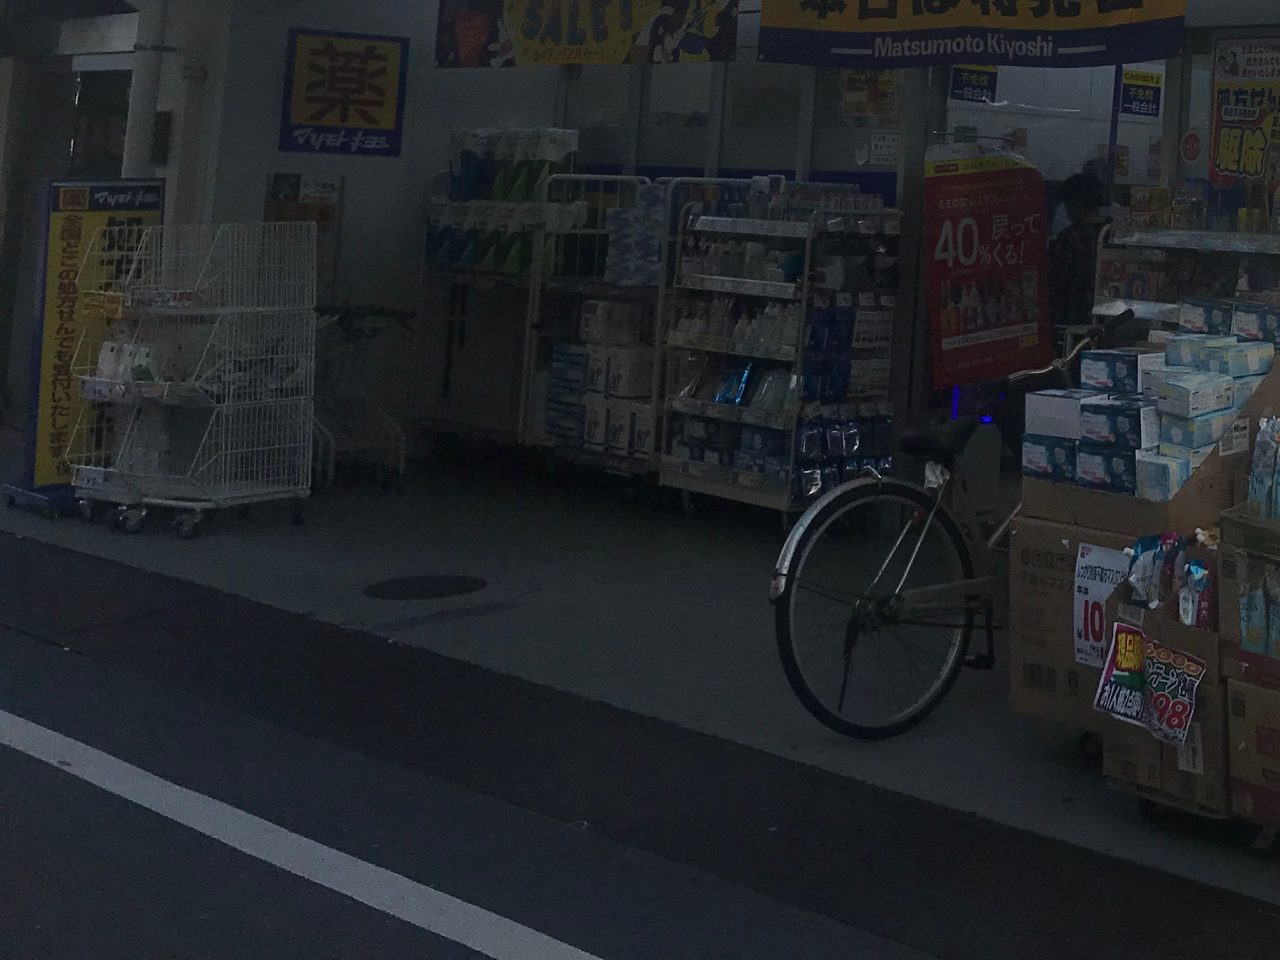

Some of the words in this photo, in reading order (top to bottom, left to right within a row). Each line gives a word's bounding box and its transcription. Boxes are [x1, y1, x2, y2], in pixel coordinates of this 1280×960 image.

[874, 35, 984, 58] Matsumoto
[987, 33, 1053, 60] Kiyoshi
[305, 41, 388, 125] 薬
[293, 128, 391, 152] マツモトキヨシ
